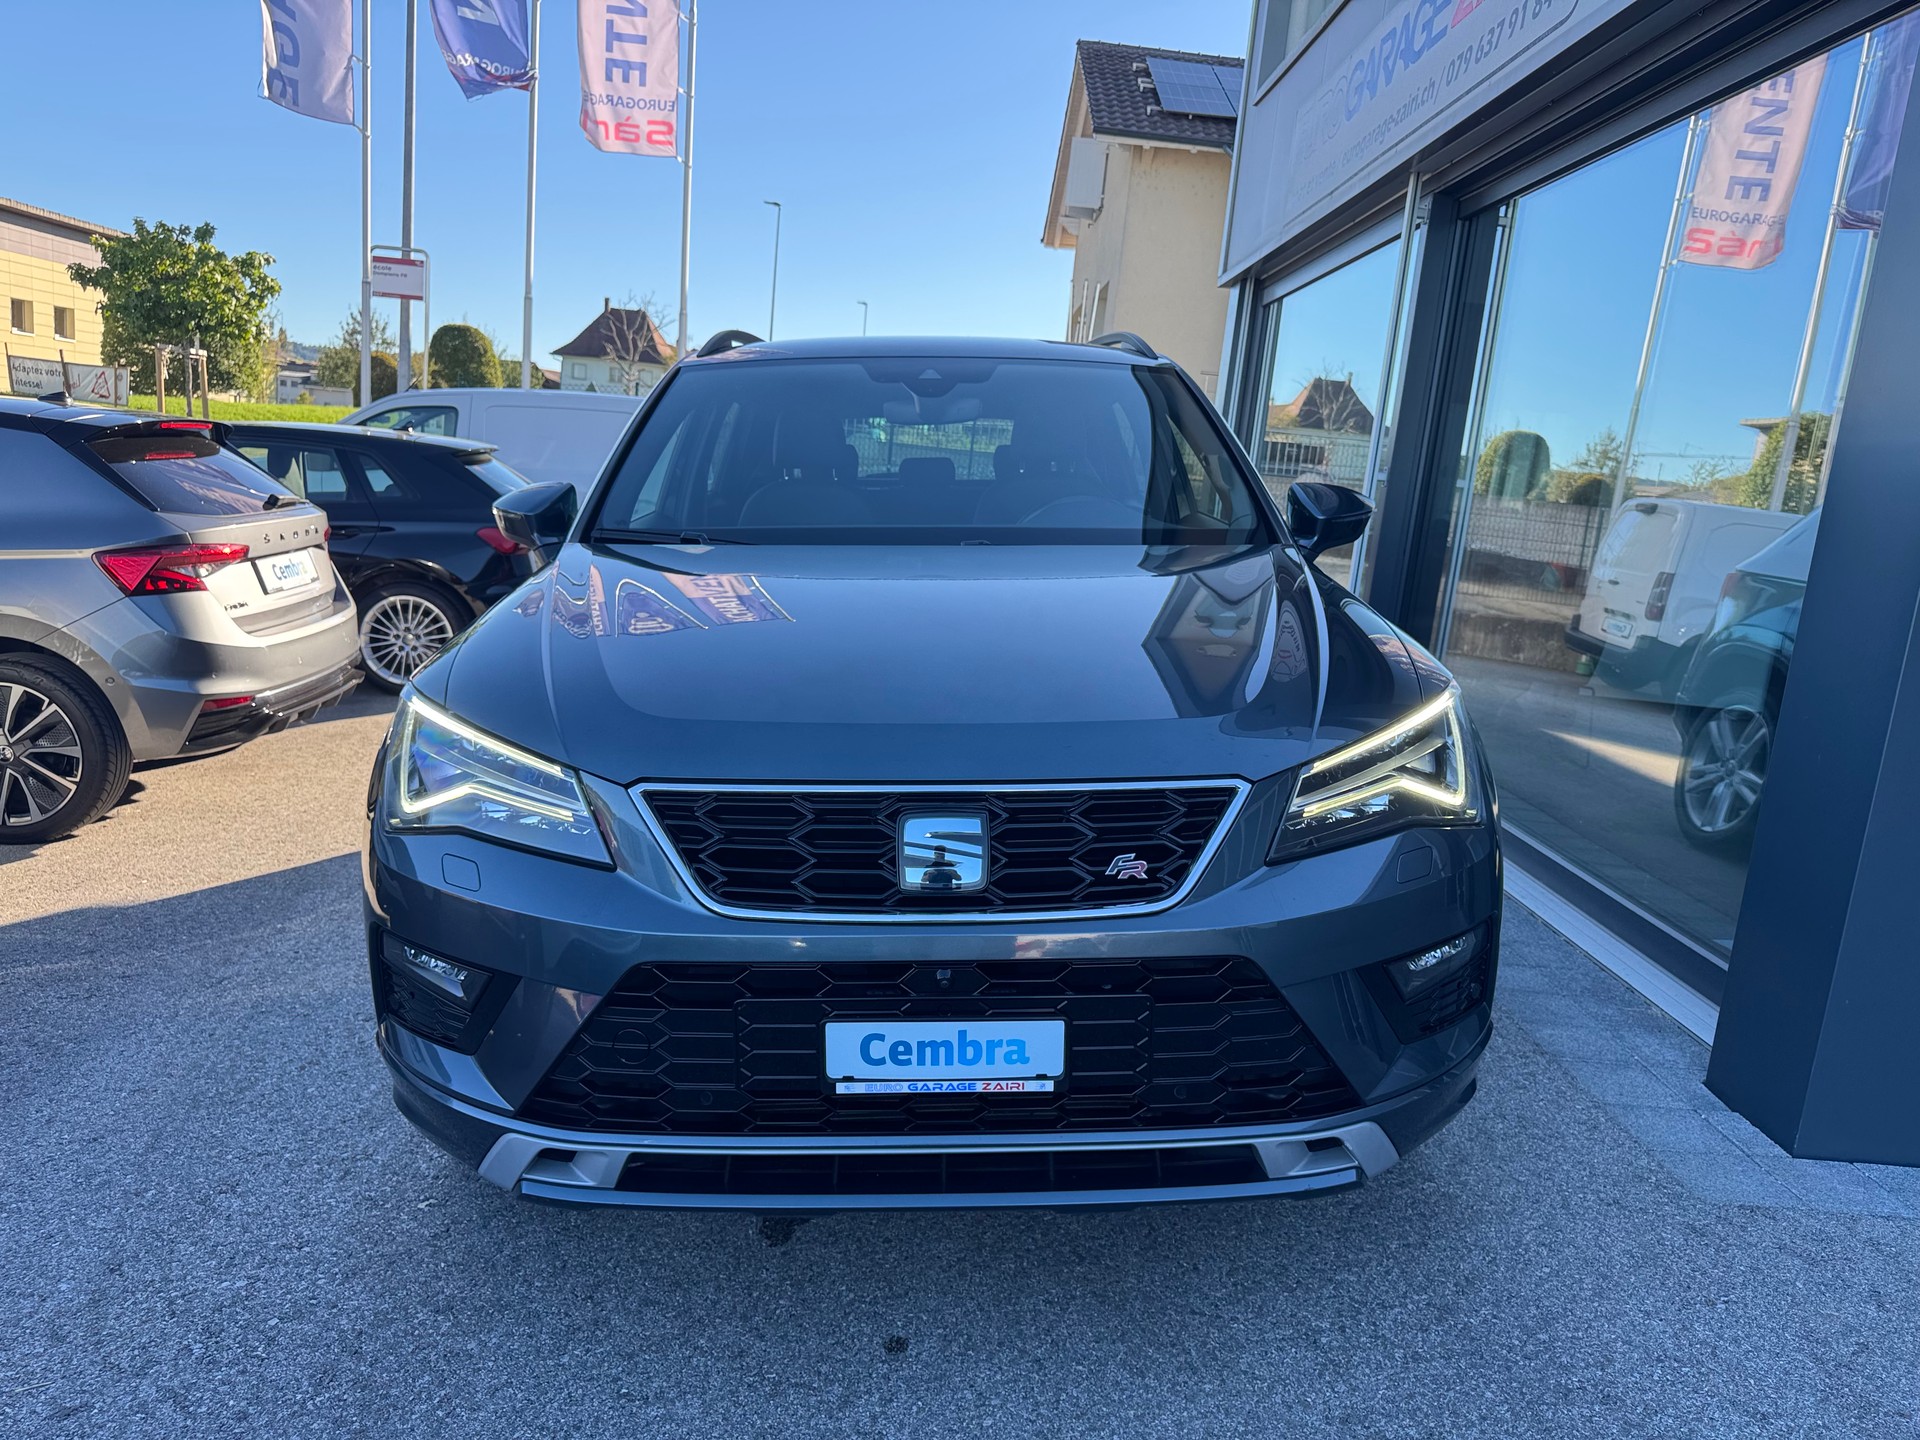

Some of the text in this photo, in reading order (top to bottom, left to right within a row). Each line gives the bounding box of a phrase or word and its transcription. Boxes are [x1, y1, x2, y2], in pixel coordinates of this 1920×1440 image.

[1445, 44, 1474, 88] 079
[1475, 17, 1506, 65] 637
[1508, 0, 1528, 40] 91
[1531, 0, 1552, 21] 8
[1691, 206, 1786, 227] EUROGARAGE
[271, 558, 308, 582] Cembra
[1104, 852, 1148, 880] FR
[859, 1029, 1031, 1067] Cembra
[865, 1082, 1025, 1092] EURO GARAGE ZAIRI
